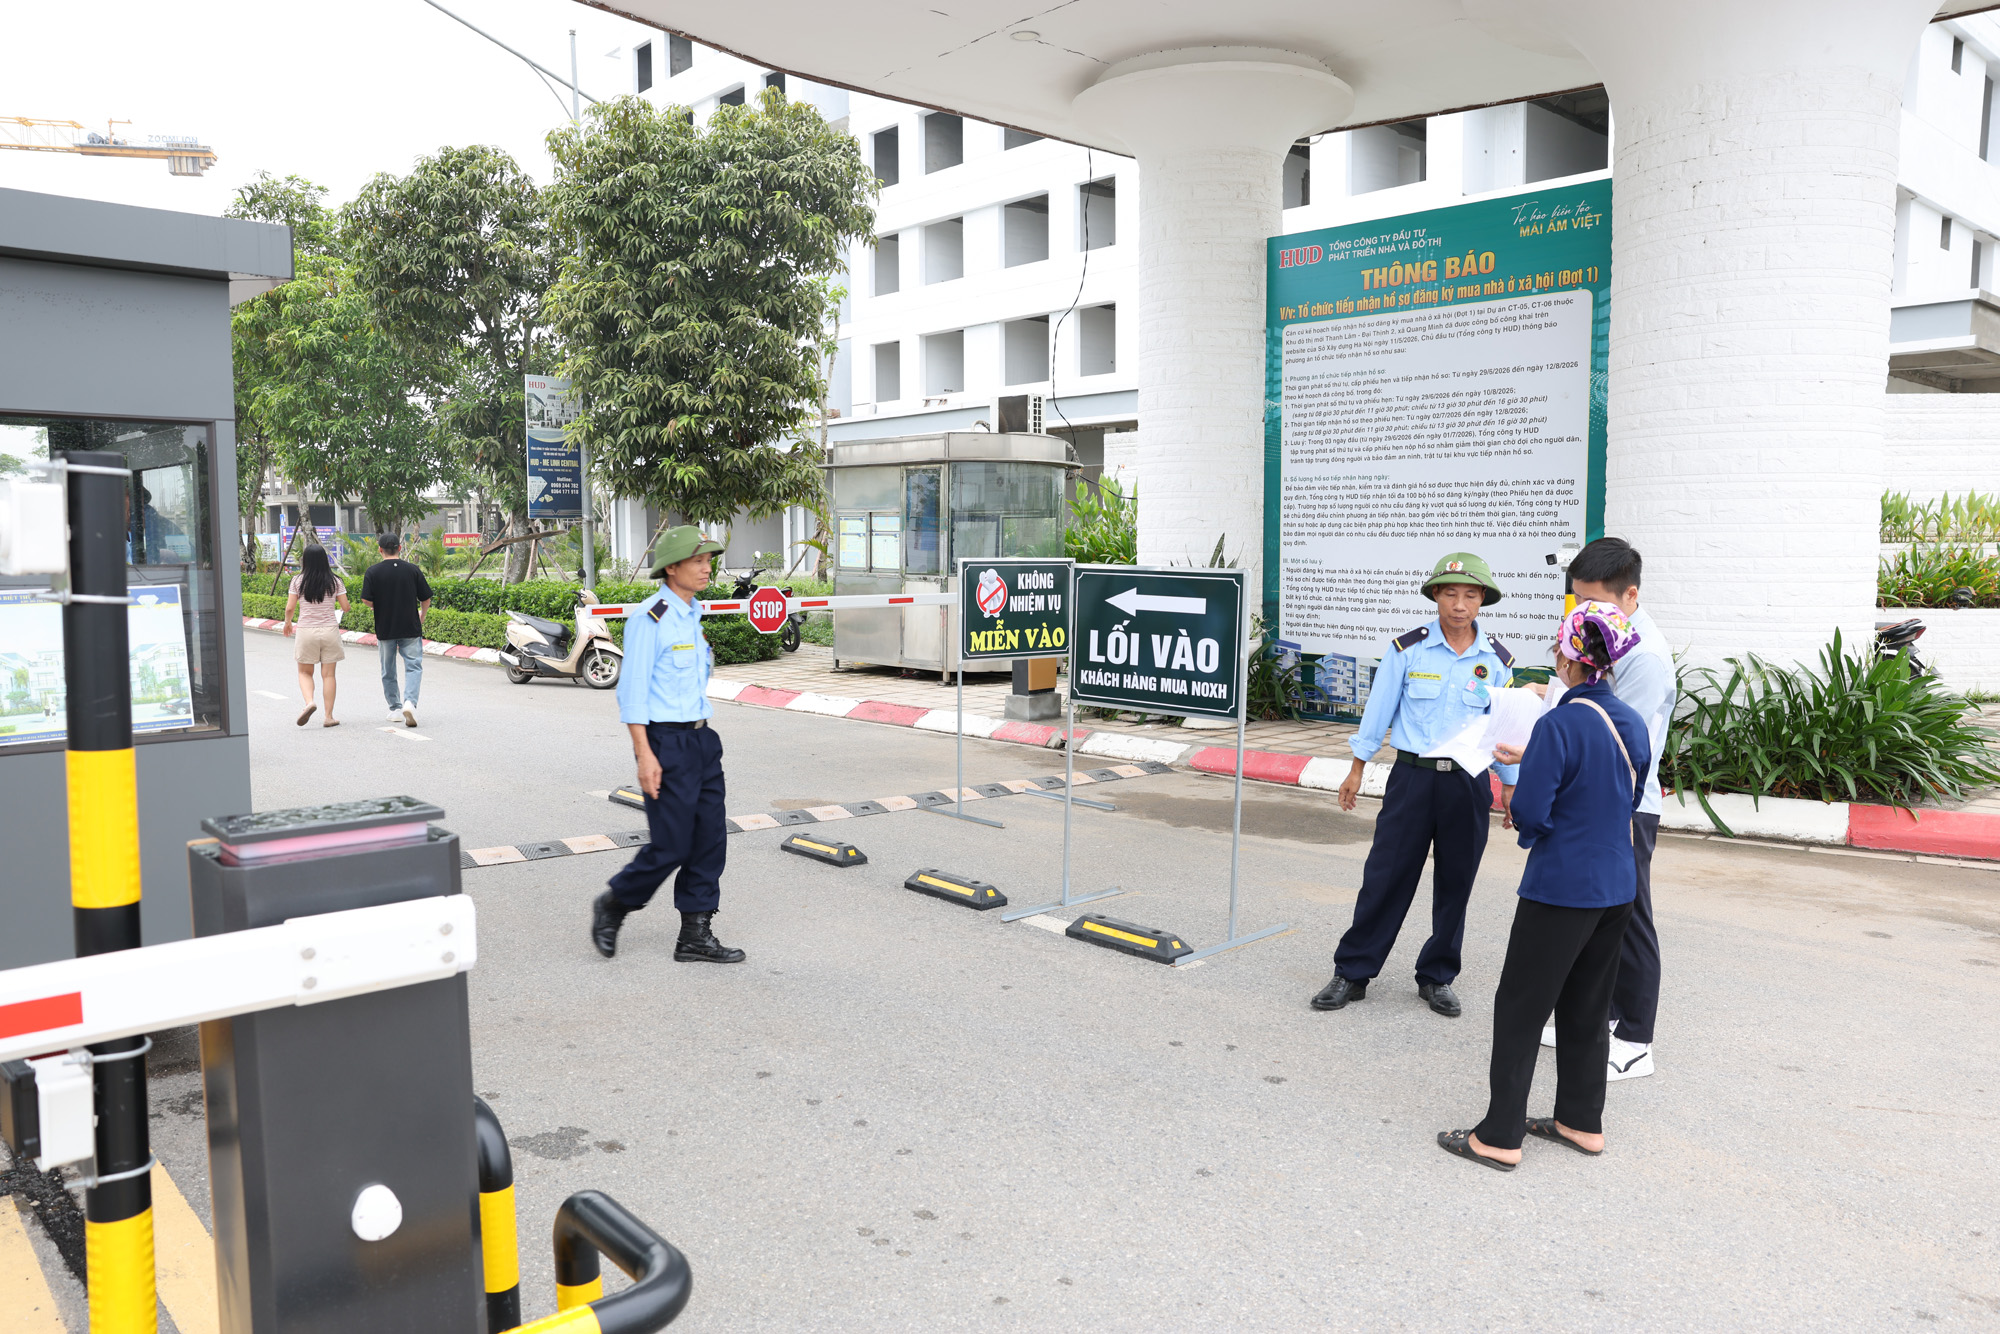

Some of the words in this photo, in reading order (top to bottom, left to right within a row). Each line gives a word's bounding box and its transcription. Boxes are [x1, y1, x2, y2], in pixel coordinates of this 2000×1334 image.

[1530, 208, 1548, 221] hào
[1551, 205, 1573, 217] kiến
[1575, 200, 1592, 216] tạo
[1520, 222, 1543, 237] MÁI
[1546, 217, 1567, 233] ẤM
[1572, 213, 1602, 229] VIỆT
[1328, 251, 1350, 261] PHÁT
[1352, 246, 1376, 258] TRIỂN
[1378, 243, 1396, 254] NHÀ
[1398, 240, 1410, 251] VÀ
[1412, 238, 1425, 248] ĐÔ
[1427, 237, 1442, 247] THỊ
[1329, 240, 1351, 251] TỔNG
[1354, 237, 1377, 247] CÔNG
[1380, 235, 1391, 244] TY
[1393, 230, 1411, 242] ĐẦU
[1413, 229, 1426, 237] TƯ
[1279, 245, 1323, 268] HUD
[1361, 260, 1437, 290] THÔNG
[1445, 249, 1495, 279] BÁO
[1280, 306, 1296, 320] V/v:
[1298, 301, 1308, 318] Tổ
[1311, 301, 1333, 316] chức
[1336, 296, 1354, 314] tiếp
[1356, 296, 1381, 312] nhận
[1384, 291, 1396, 308] hồ
[1398, 292, 1410, 306] sơ
[1413, 289, 1438, 304] đăng
[1442, 285, 1454, 302] ký
[1457, 284, 1480, 299] mua
[1484, 278, 1504, 295] nhà
[1508, 275, 1515, 292] ở
[1518, 275, 1532, 292] xã
[1536, 272, 1554, 291] hội
[1558, 269, 1582, 287] (Đợt
[1586, 266, 1598, 284] 1)
[1486, 306, 1496, 314] Dự
[1507, 302, 1529, 312] CT-05,
[1531, 299, 1552, 308] CT-06
[1553, 297, 1574, 306] thuộc
[1494, 326, 1501, 334] ty
[1502, 324, 1520, 333] HUD)
[1522, 321, 1542, 331] thông
[1499, 314, 1517, 324] công
[1526, 363, 1543, 372] ngày
[1546, 360, 1578, 370] 12/8/2026
[1529, 394, 1547, 403] phút)
[1528, 415, 1547, 424] phút)
[1544, 435, 1564, 444] người
[1535, 499, 1552, 507] công
[1554, 498, 1561, 506] ty
[1536, 509, 1558, 517] cường
[1018, 570, 1054, 589] KHÔNG
[1543, 571, 1559, 579] nộp;
[1009, 594, 1044, 615] NHIỆM
[1048, 594, 1061, 614] VỤ
[1534, 592, 1554, 600] thông
[753, 600, 783, 619] STOP
[970, 620, 1020, 652] MIỄN
[1024, 622, 1065, 648] VÀO
[1537, 633, 1548, 641] gìn
[1089, 620, 1139, 666] LỐI
[1151, 628, 1220, 673] VÀO
[1080, 667, 1120, 687] KHÁCH
[1123, 672, 1157, 692] HÀNG
[1160, 678, 1188, 695] MUA
[1191, 681, 1227, 699] NOXH
